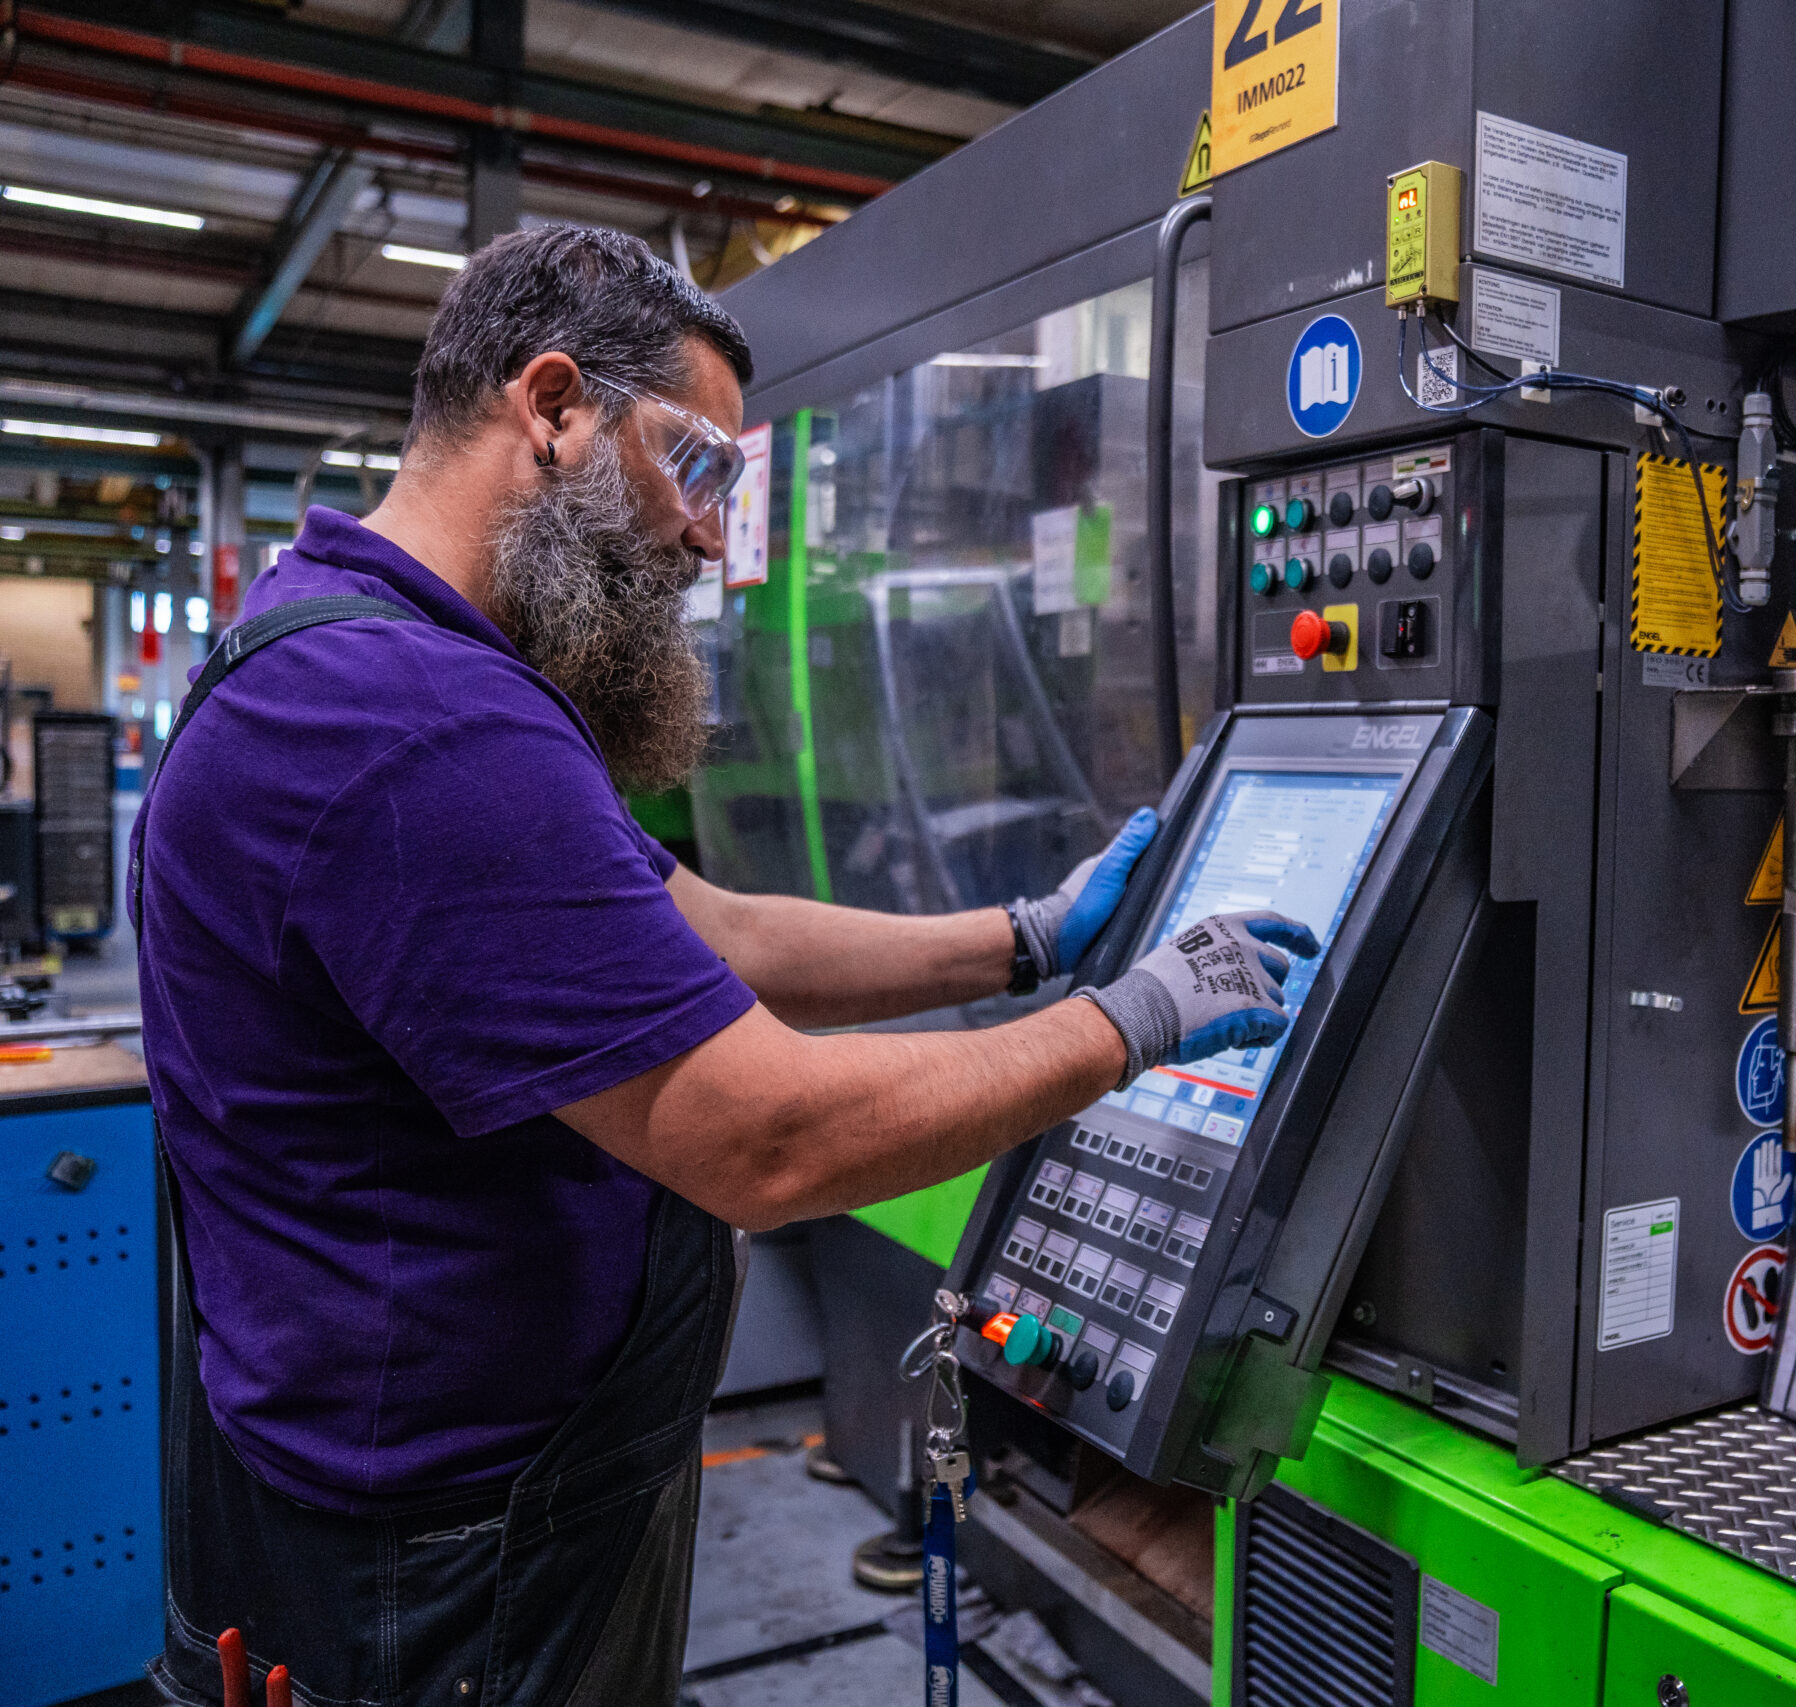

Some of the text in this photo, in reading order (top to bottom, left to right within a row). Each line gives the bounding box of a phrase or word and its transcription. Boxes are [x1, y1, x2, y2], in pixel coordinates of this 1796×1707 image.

[1237, 63, 1306, 115] IMM022
[1478, 278, 1500, 288] ACHTUNG
[1478, 302, 1502, 312] ATTENTION
[1352, 726, 1423, 750] ENGEL
[1177, 931, 1214, 954] B
[1611, 1218, 1635, 1229] Service
[929, 1574, 947, 1616] JUMBO
